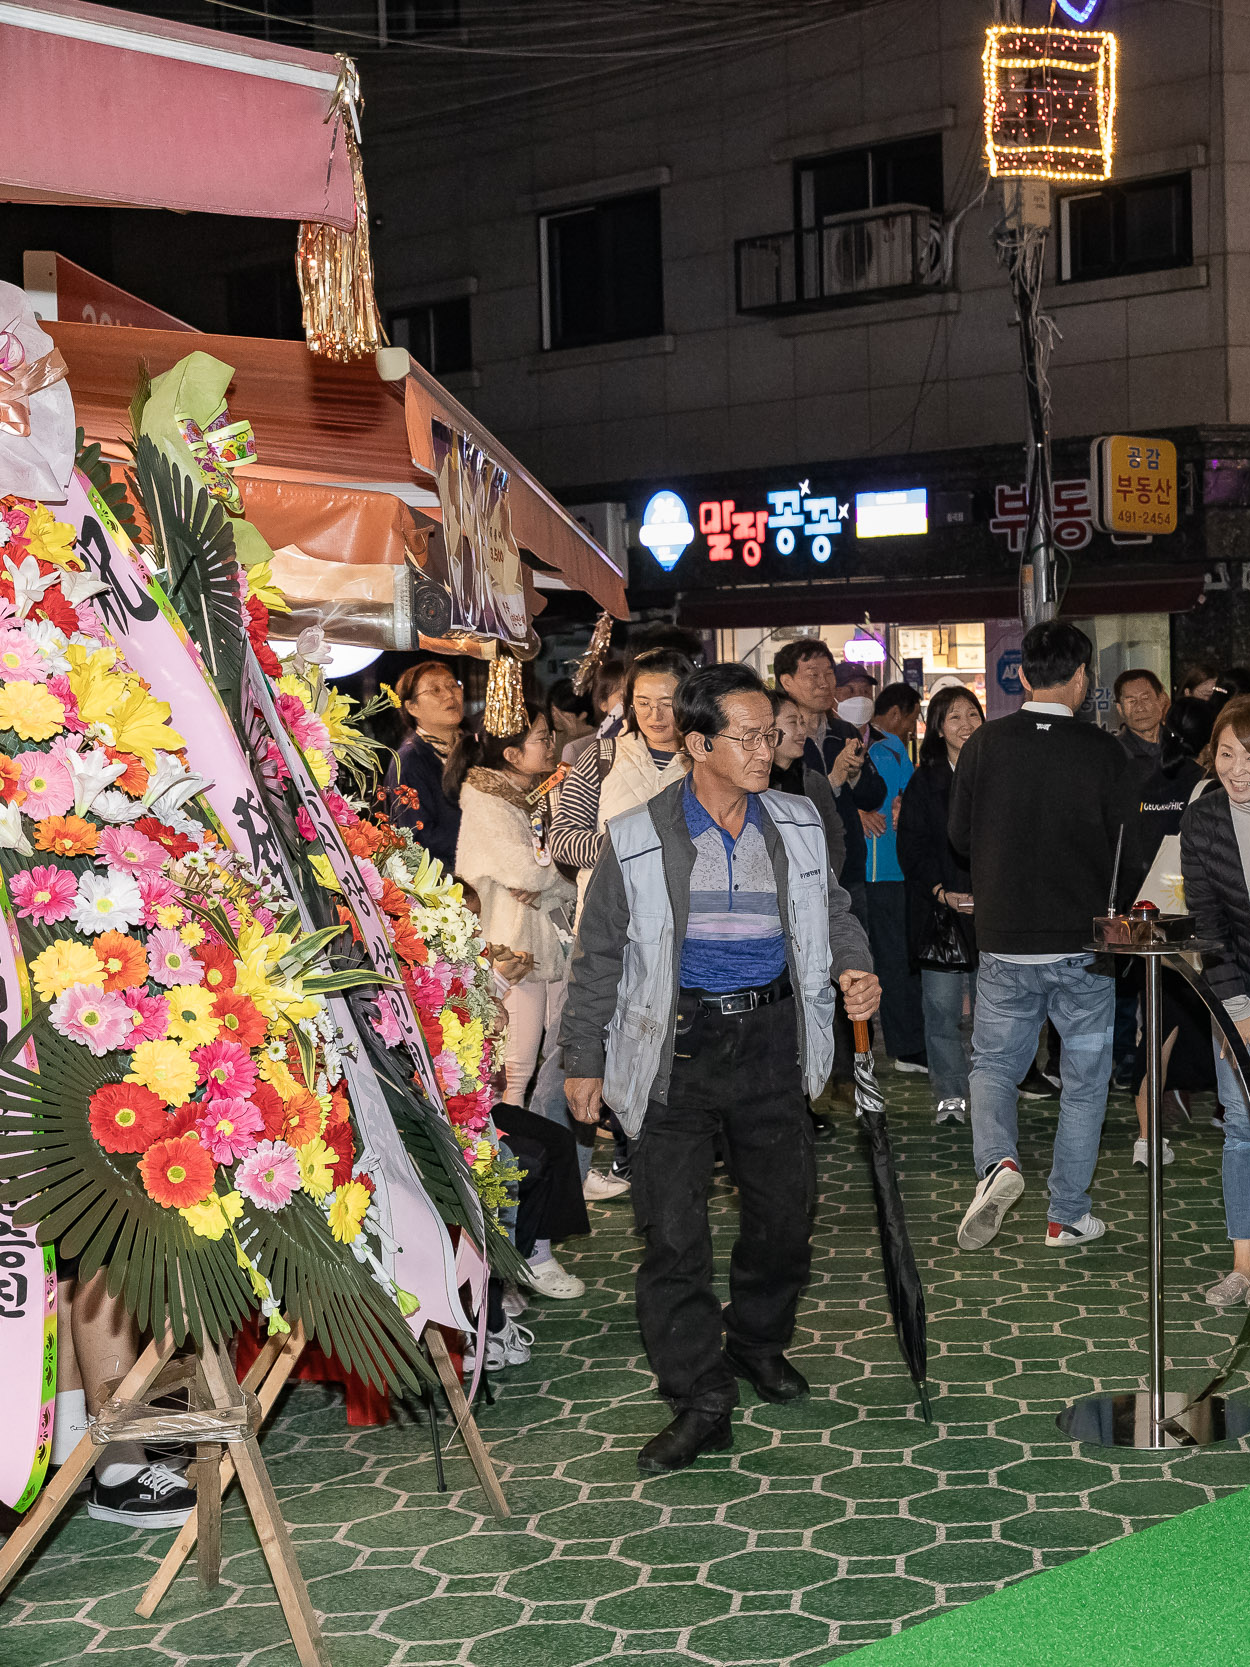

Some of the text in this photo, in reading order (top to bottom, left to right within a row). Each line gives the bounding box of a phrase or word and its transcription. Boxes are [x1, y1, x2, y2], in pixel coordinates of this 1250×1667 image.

[1127, 445, 1161, 470] 공감
[1116, 474, 1172, 506] 부동산
[990, 479, 1093, 550] 부동
[1117, 511, 1171, 526] 491-2454
